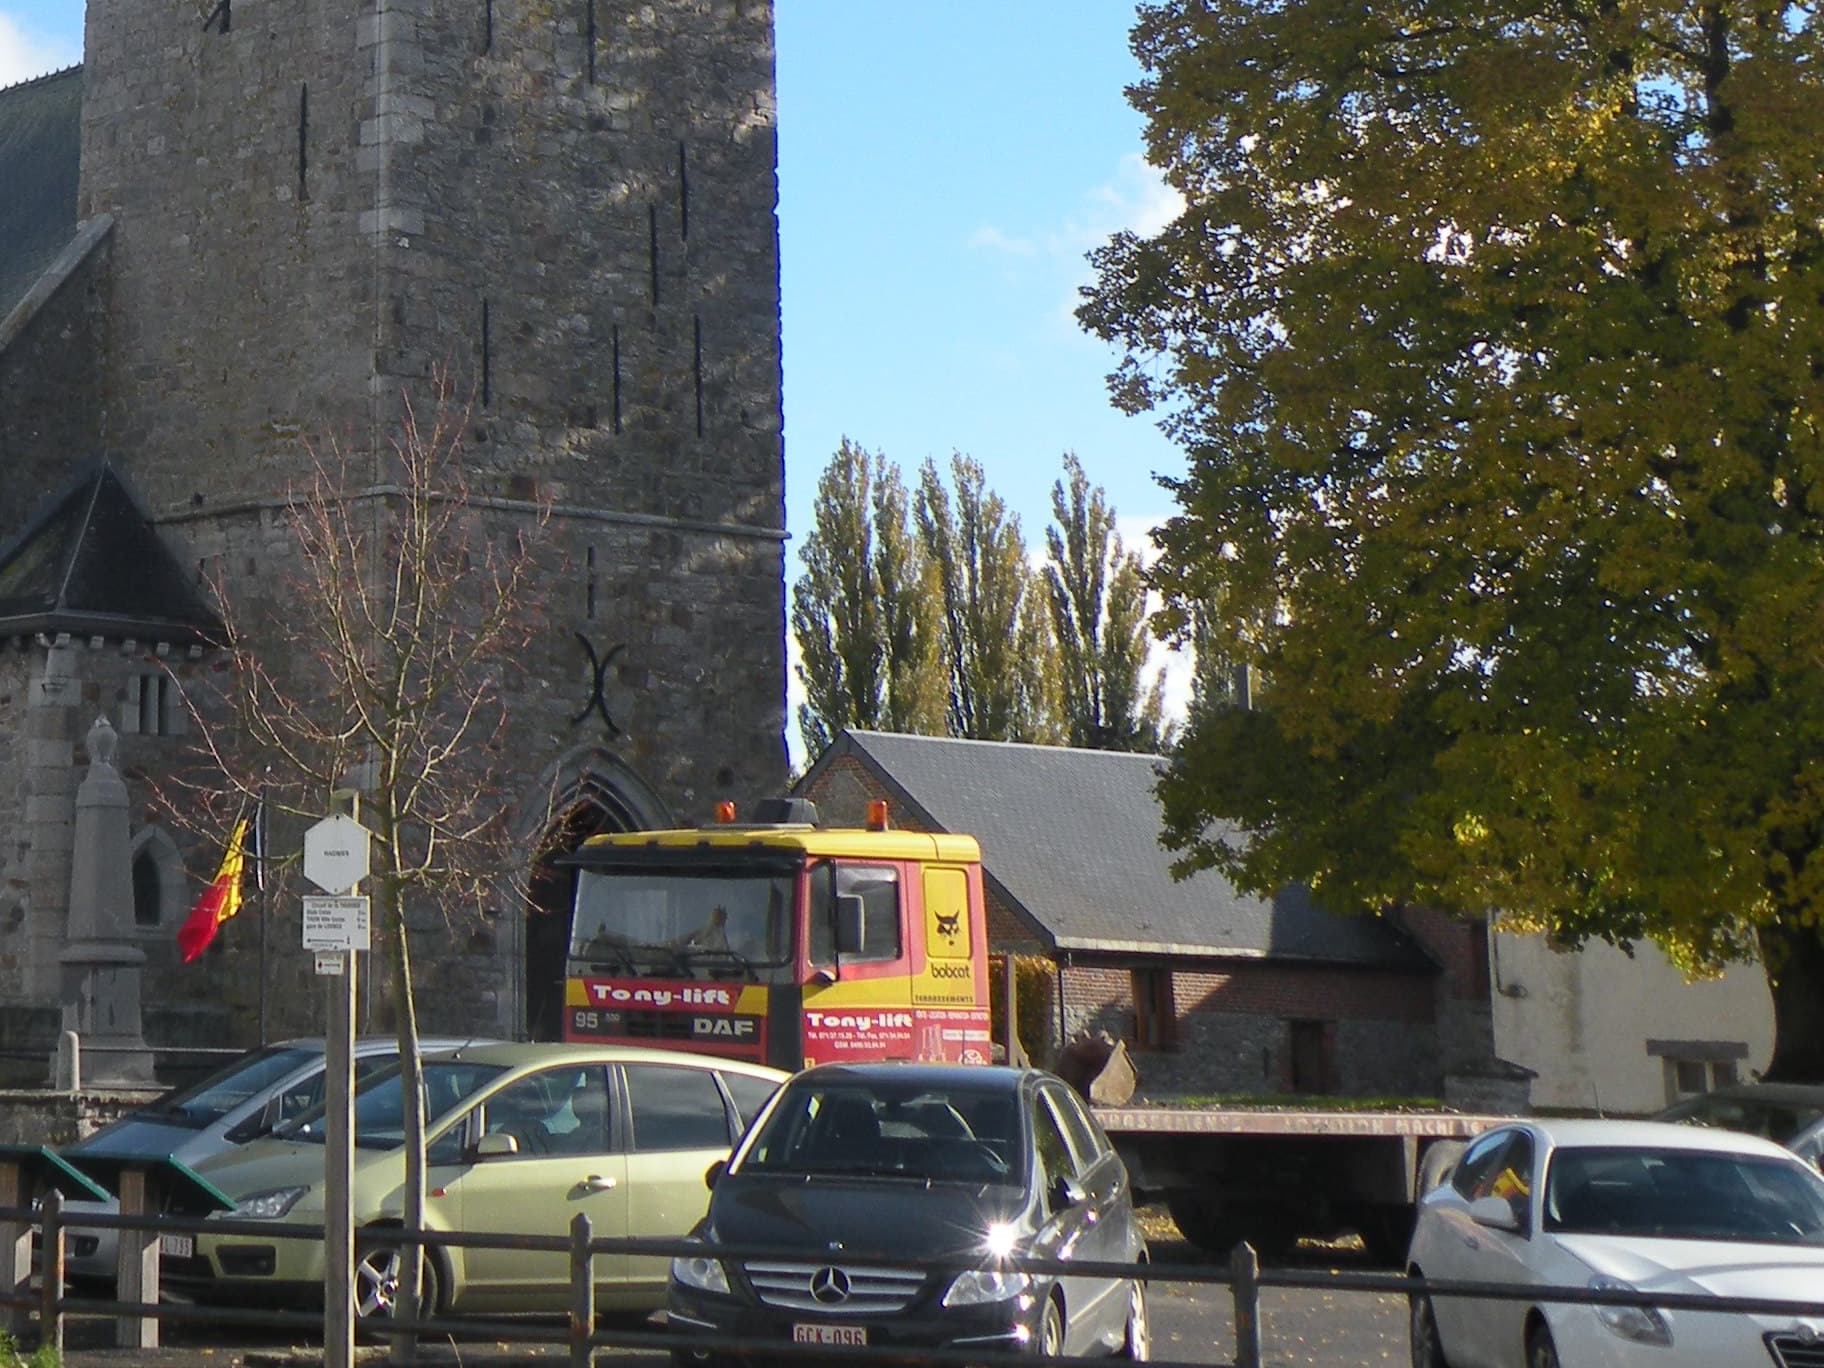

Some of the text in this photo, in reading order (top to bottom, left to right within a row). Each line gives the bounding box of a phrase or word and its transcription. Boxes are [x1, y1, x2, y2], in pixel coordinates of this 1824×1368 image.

[931, 963, 971, 979] bobcat
[592, 984, 731, 1006] Tony-lift
[575, 1011, 599, 1029] 95
[693, 1017, 754, 1037] DAF
[806, 1013, 913, 1031] Tony-lift
